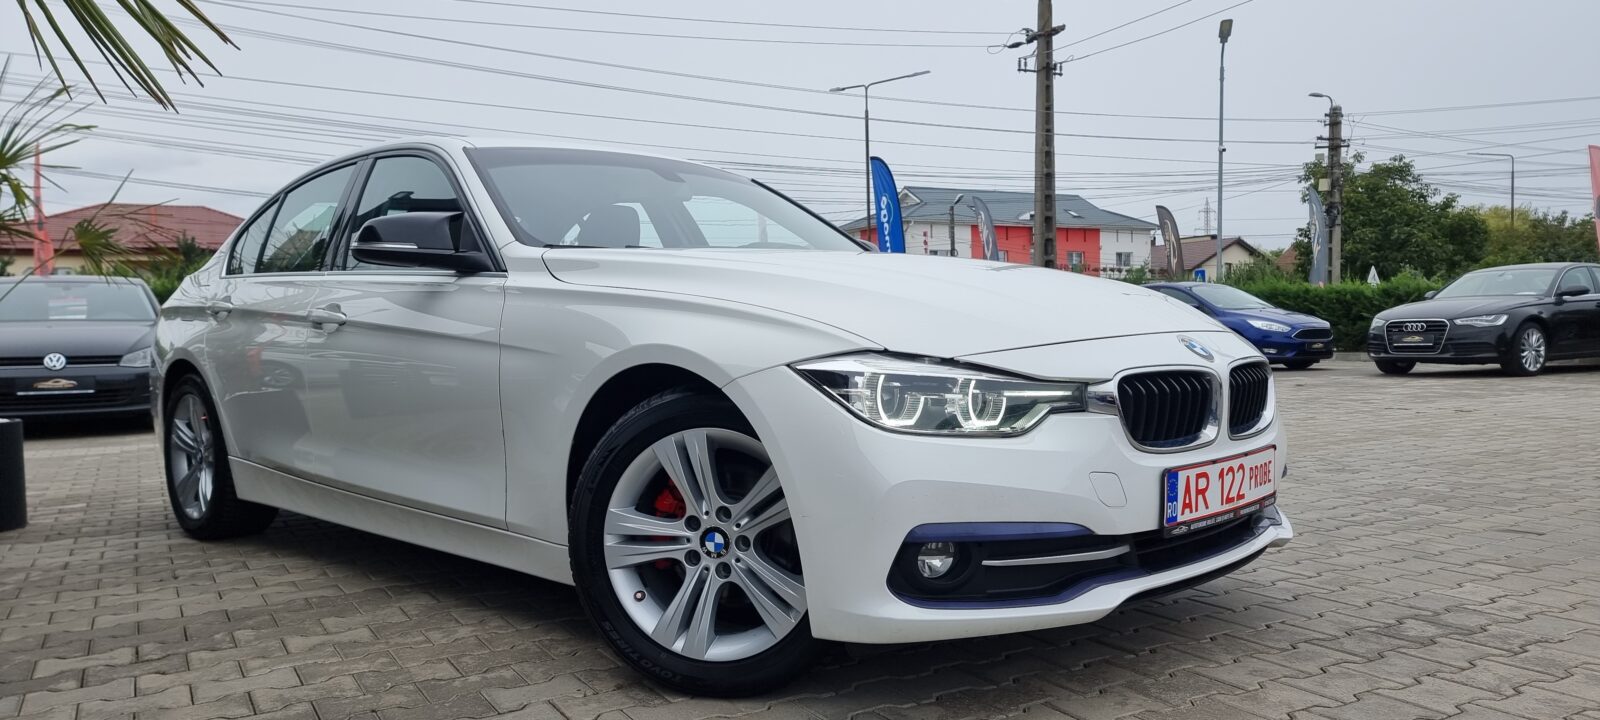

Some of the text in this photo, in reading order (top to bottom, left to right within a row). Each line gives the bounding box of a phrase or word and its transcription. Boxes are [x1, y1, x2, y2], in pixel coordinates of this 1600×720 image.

[1181, 472, 1210, 516] AR
[1218, 463, 1245, 506] 122
[1249, 460, 1272, 490] PROBE
[1167, 501, 1177, 518] RO
[639, 658, 682, 682] TOYO
